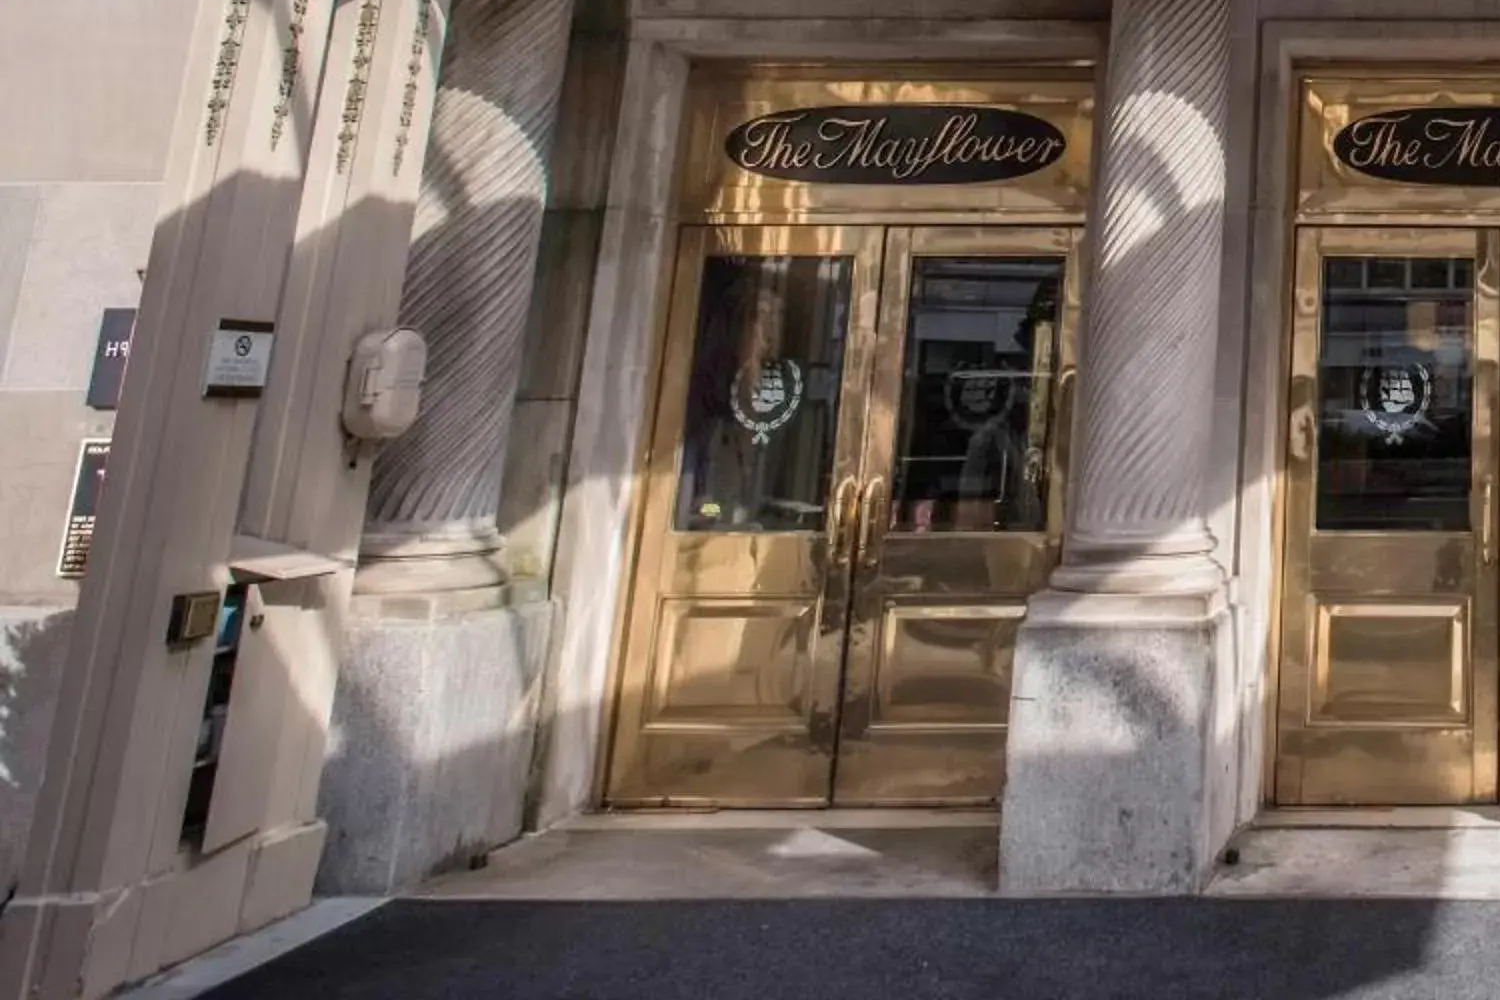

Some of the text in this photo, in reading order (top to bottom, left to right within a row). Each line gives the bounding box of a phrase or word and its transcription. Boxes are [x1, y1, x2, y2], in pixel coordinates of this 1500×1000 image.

[740, 112, 1064, 179] The Mayflower
[1350, 113, 1422, 168] The
